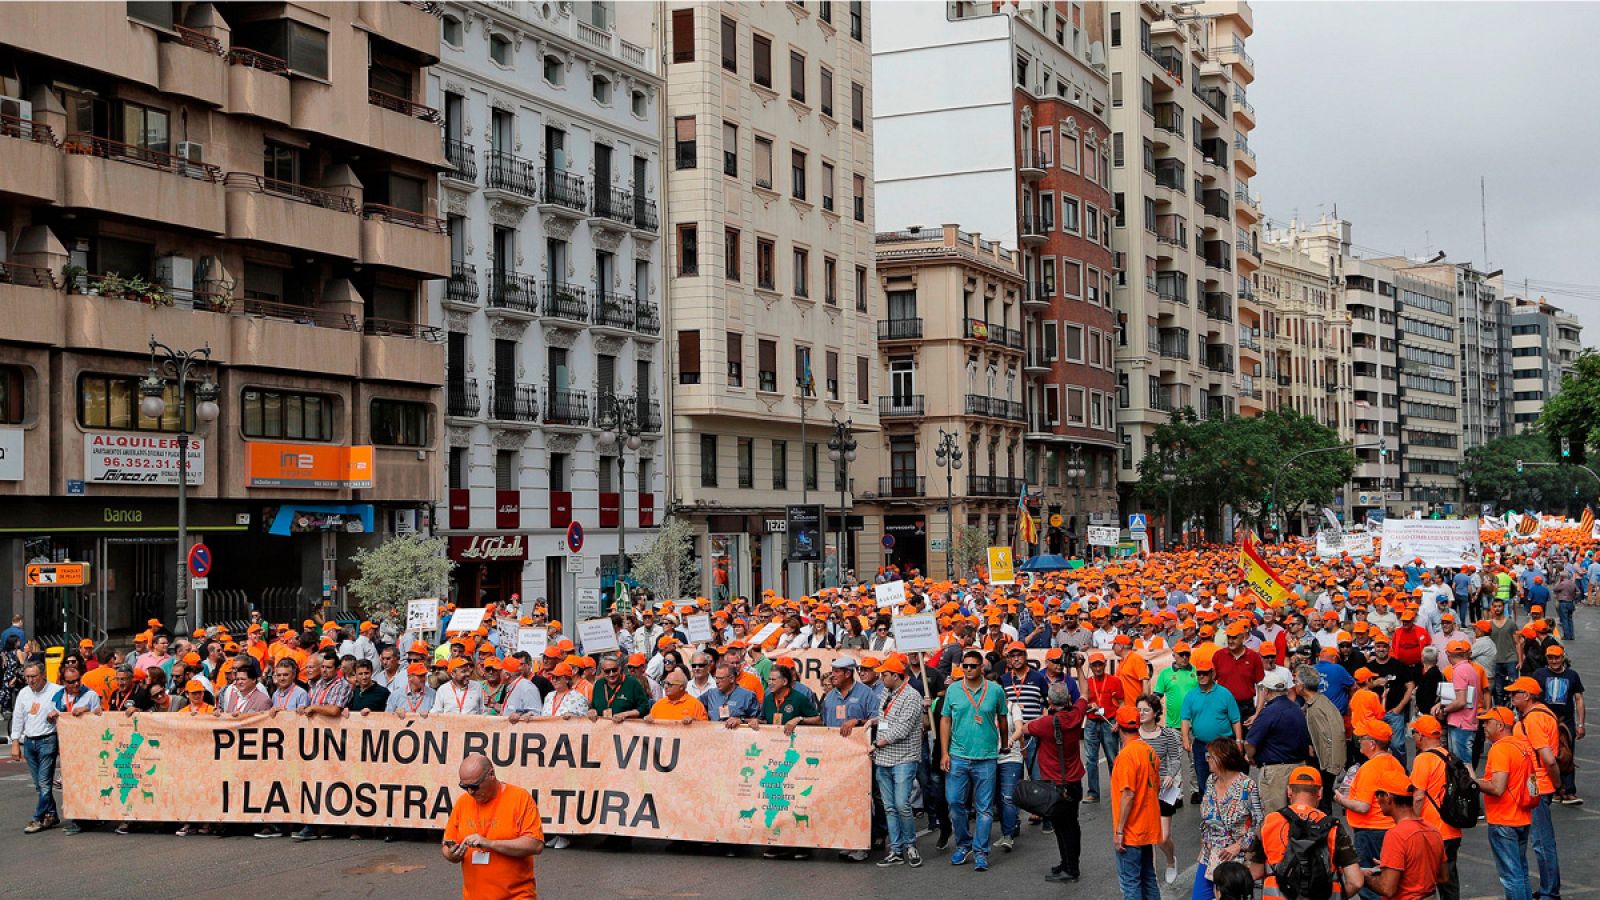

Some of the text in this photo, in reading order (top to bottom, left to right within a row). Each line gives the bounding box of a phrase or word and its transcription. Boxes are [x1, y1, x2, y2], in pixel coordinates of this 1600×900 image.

[93, 435, 200, 450] ALQUILERS
[104, 508, 142, 522] Bankia
[558, 540, 565, 552] 12
[1264, 578, 1274, 588] EL
[1250, 581, 1272, 602] PICAZO
[213, 720, 681, 772] PER UN MÓN RURAL VIU
[222, 781, 661, 829] I LA NOSTRA LTURA
